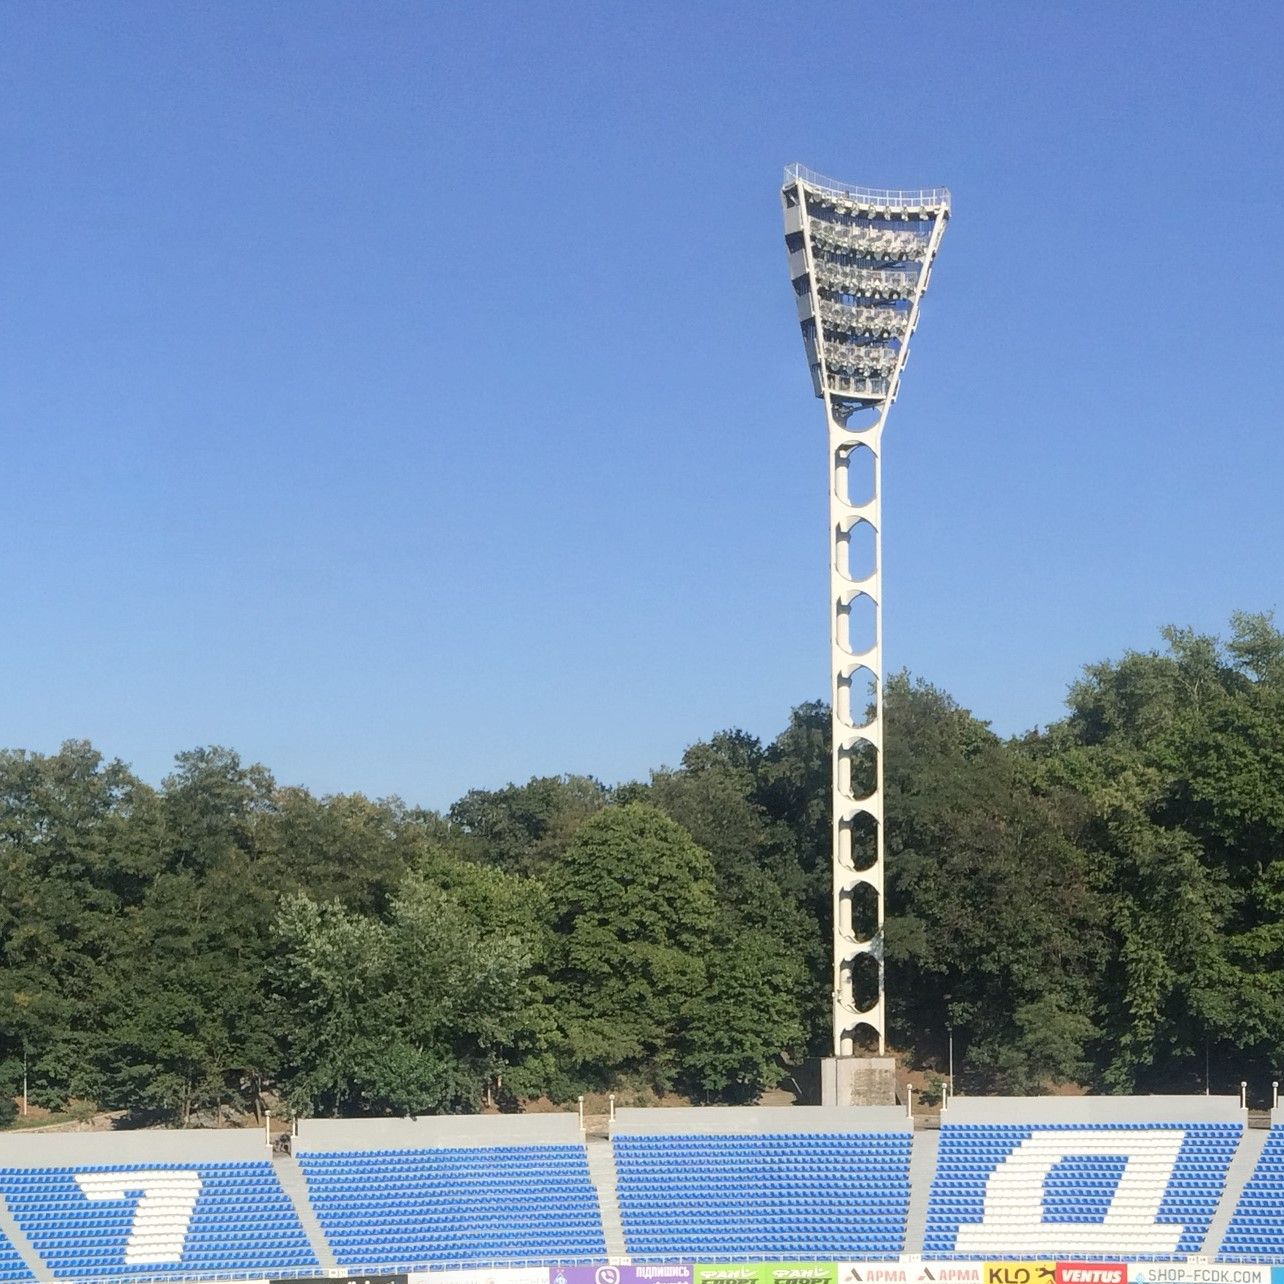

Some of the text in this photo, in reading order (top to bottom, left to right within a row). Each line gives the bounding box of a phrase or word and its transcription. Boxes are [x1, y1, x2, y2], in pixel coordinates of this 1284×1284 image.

[636, 1266, 690, 1279] ПІДПИШИСЬ
[866, 1270, 907, 1281] АРМА
[939, 1269, 980, 1280] АРМА
[989, 1268, 1030, 1284] KLO
[1061, 1270, 1122, 1283] VENTUS
[1148, 1269, 1262, 1283] SHOP-FCDK.COM
